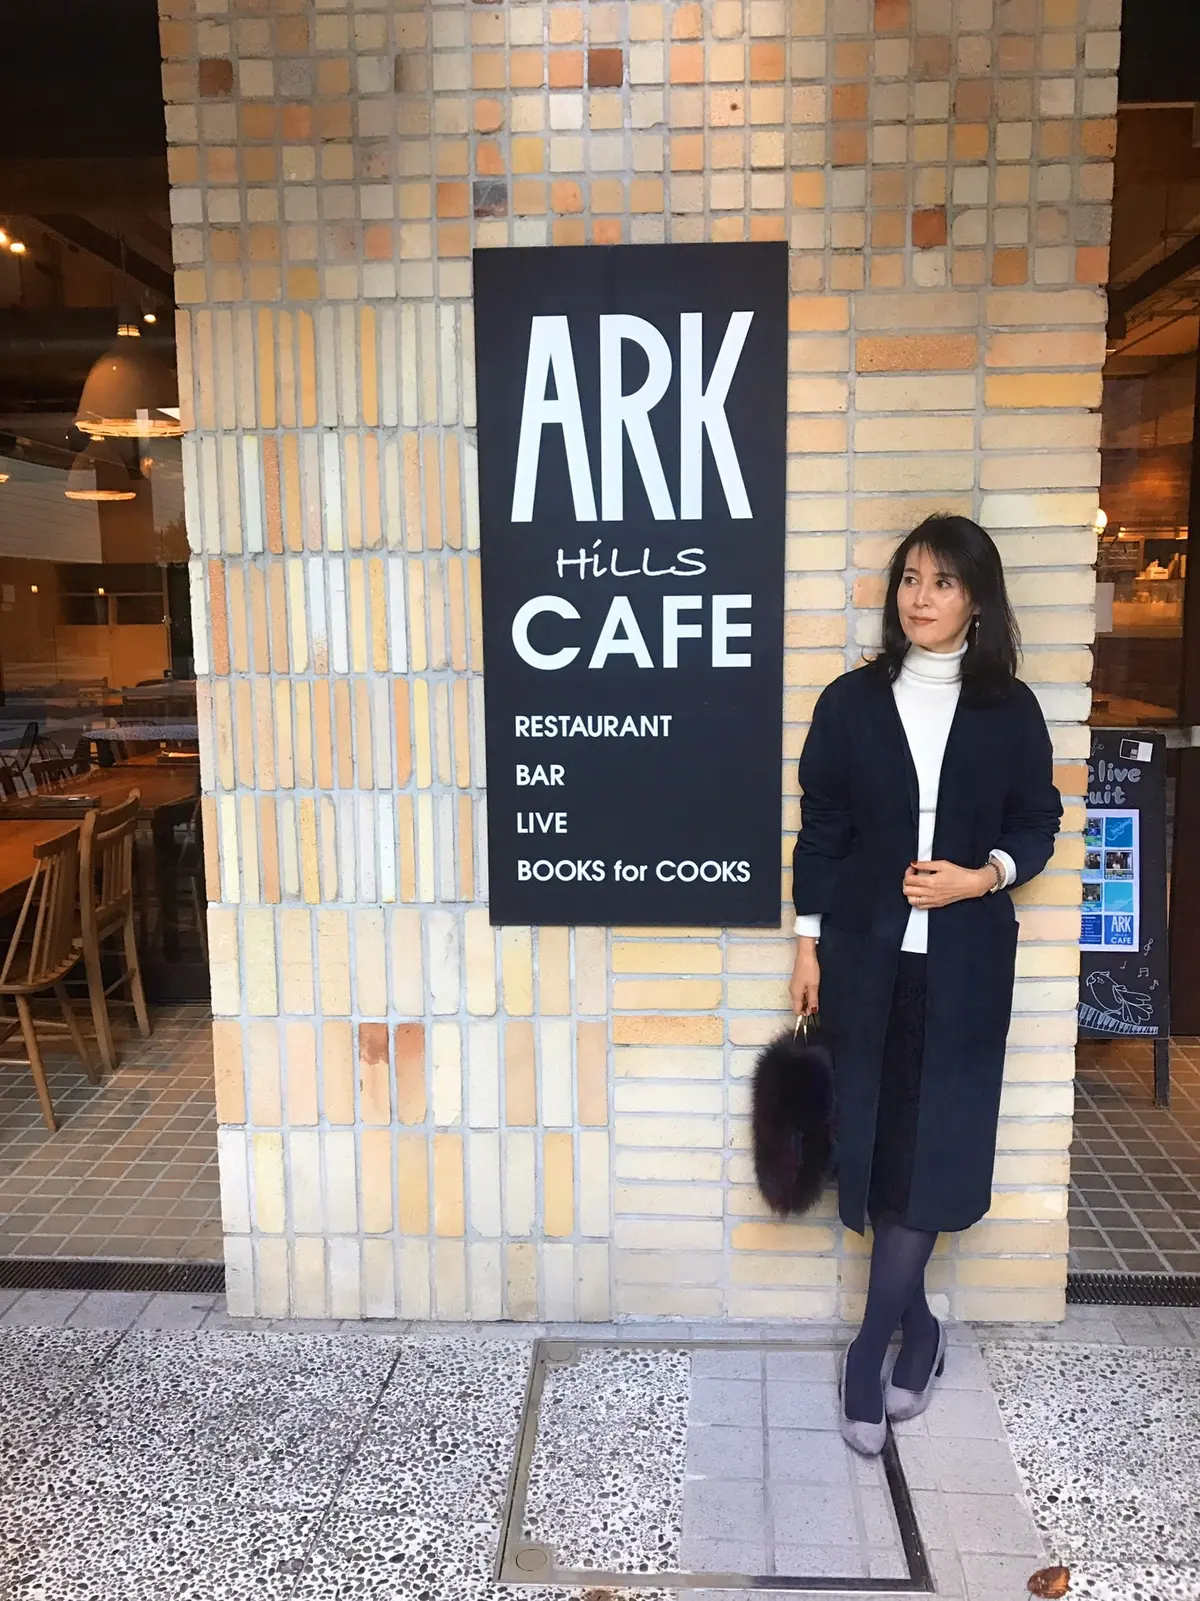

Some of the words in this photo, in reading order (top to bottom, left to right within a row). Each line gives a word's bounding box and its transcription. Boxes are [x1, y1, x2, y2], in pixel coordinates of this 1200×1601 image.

[510, 310, 755, 523] ARK
[511, 593, 753, 671] CAFE
[515, 714, 673, 739] RESTAURANT
[516, 764, 566, 787] BAR
[1098, 759, 1141, 783] live
[516, 811, 568, 834] LIVE
[517, 859, 606, 884] BOOKS
[613, 859, 648, 883] for
[655, 859, 751, 884] COOKS
[1111, 916, 1131, 933] ARK
